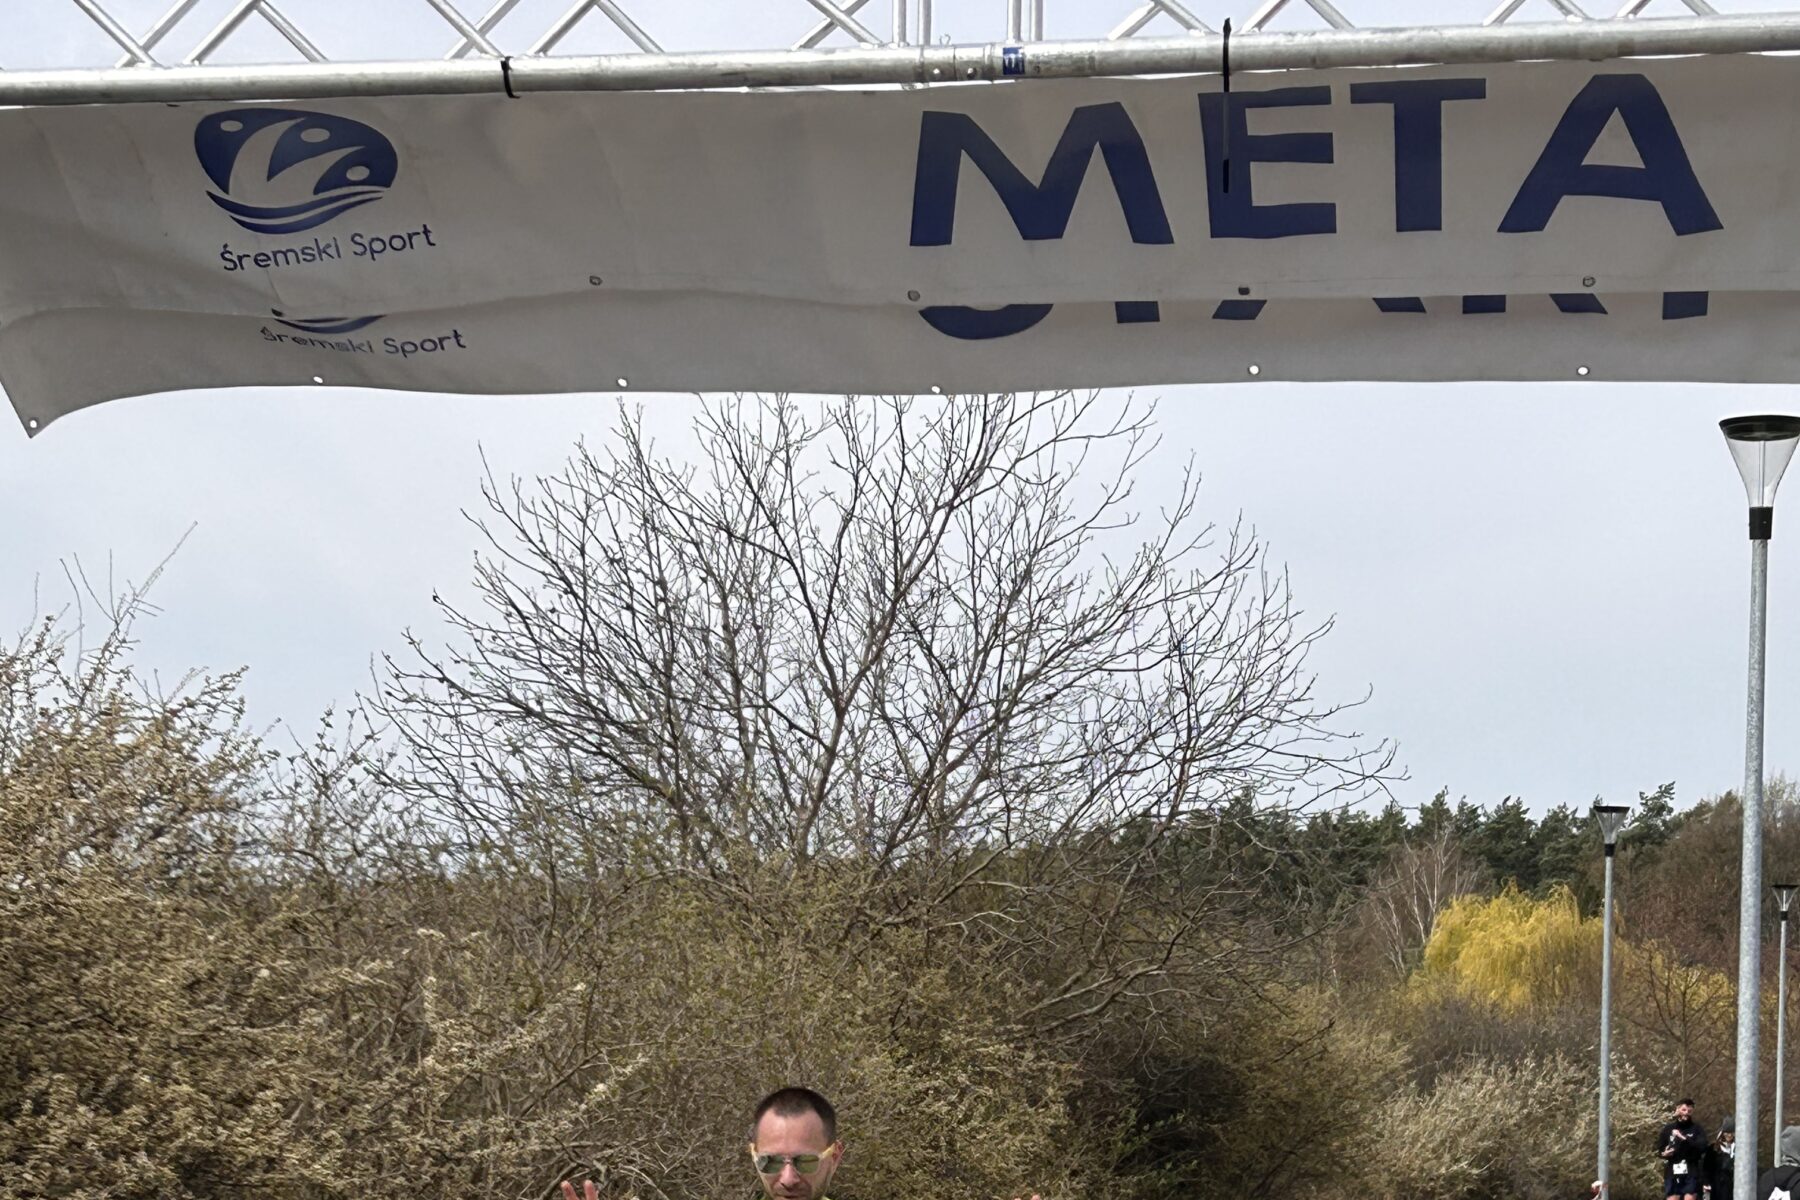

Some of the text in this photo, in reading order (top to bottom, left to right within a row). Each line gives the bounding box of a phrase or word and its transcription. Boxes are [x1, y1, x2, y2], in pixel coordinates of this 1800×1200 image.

[909, 74, 1724, 247] META
[220, 223, 436, 272] Śremski Sport
[383, 329, 467, 359] Sport
